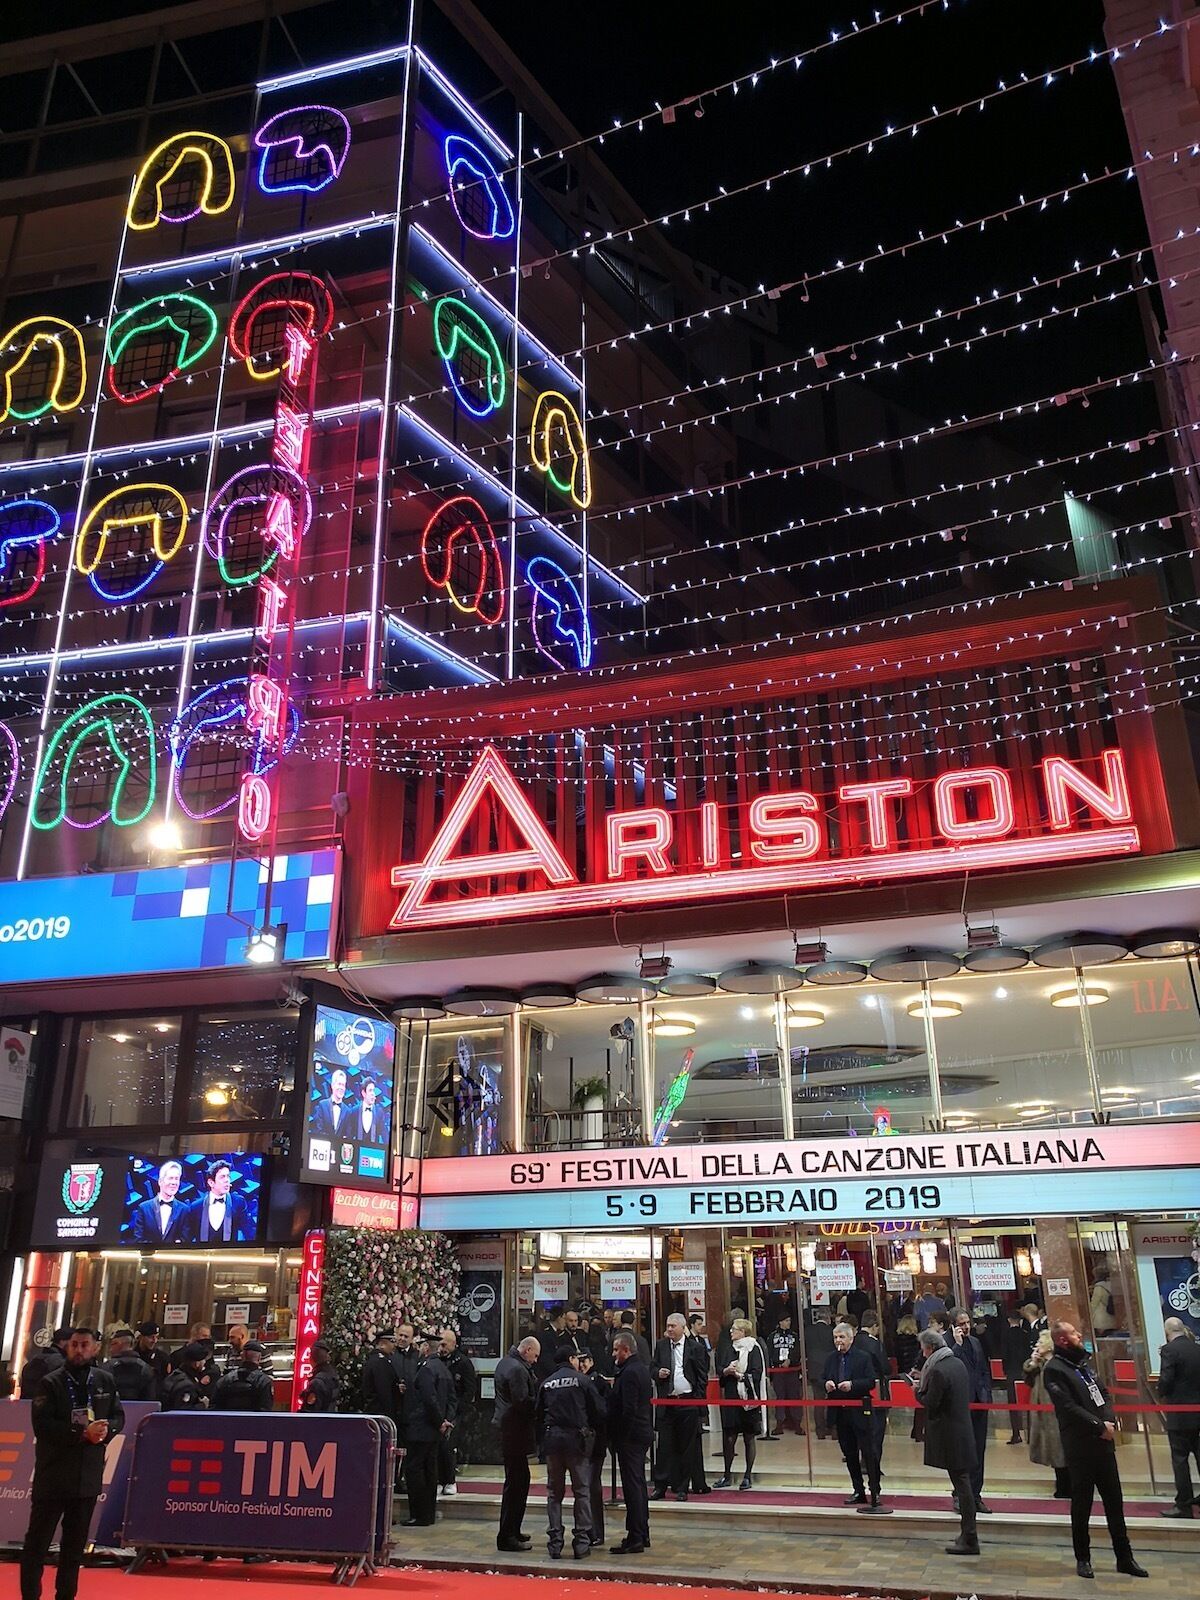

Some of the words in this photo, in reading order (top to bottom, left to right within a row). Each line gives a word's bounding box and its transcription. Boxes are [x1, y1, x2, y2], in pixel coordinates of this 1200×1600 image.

[389, 744, 1141, 930] ARISTON
[312, 1149, 328, 1161] Rai
[561, 1155, 688, 1183] FESTIVAL
[702, 1151, 793, 1178] DELLA
[801, 1145, 945, 1173] CANZONE
[956, 1137, 1105, 1168] ITALIANA
[334, 1190, 370, 1208] Teatro
[690, 1187, 838, 1215] FEBBRAIO
[865, 1185, 941, 1211] 2019
[57, 1227, 96, 1237] SANREMO
[303, 1239, 323, 1334] CINEMA
[234, 1440, 338, 1499] TIM
[165, 1499, 208, 1514] Sponsor
[209, 1500, 240, 1514] Unico
[242, 1501, 281, 1516] Festival
[283, 1503, 333, 1518] Sanremo
